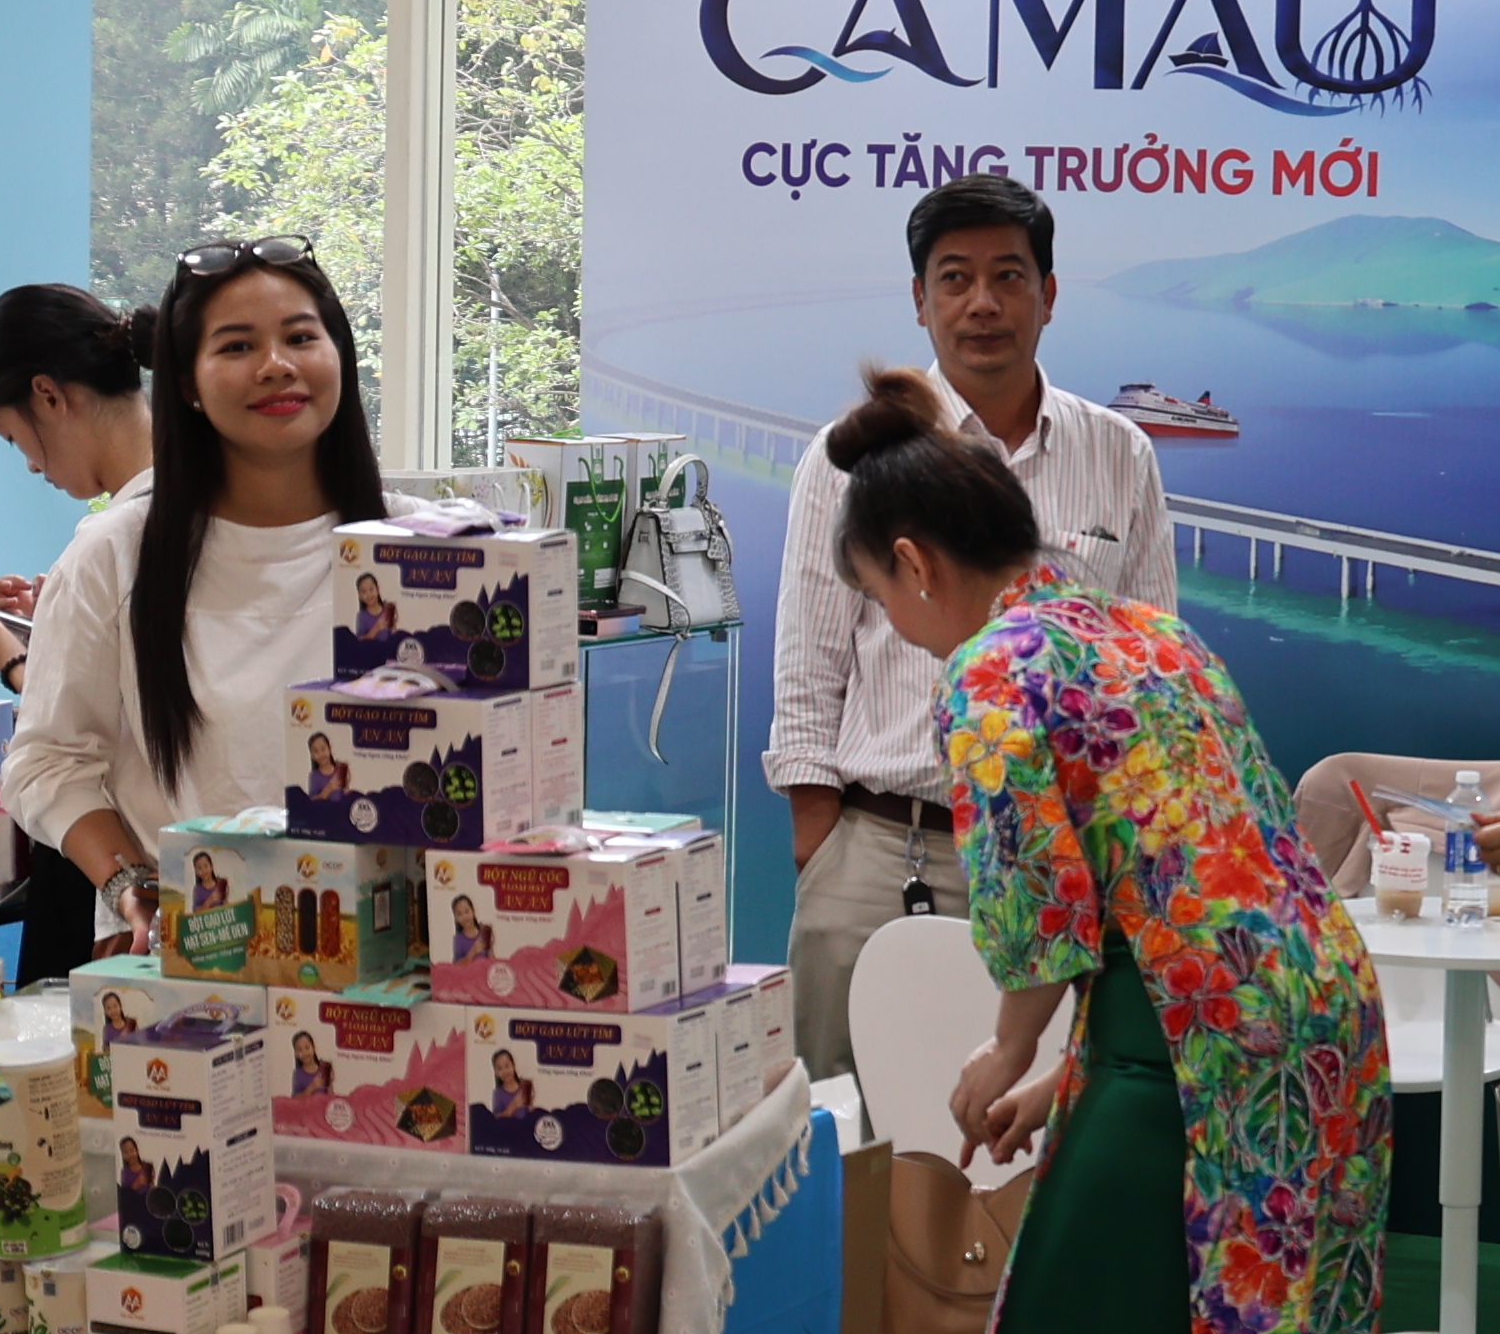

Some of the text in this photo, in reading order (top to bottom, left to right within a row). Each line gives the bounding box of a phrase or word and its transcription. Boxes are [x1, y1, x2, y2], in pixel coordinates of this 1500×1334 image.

[741, 132, 1380, 201] CỰC TĂNG TRƯỞNG MỚI
[483, 867, 507, 881] BỘT
